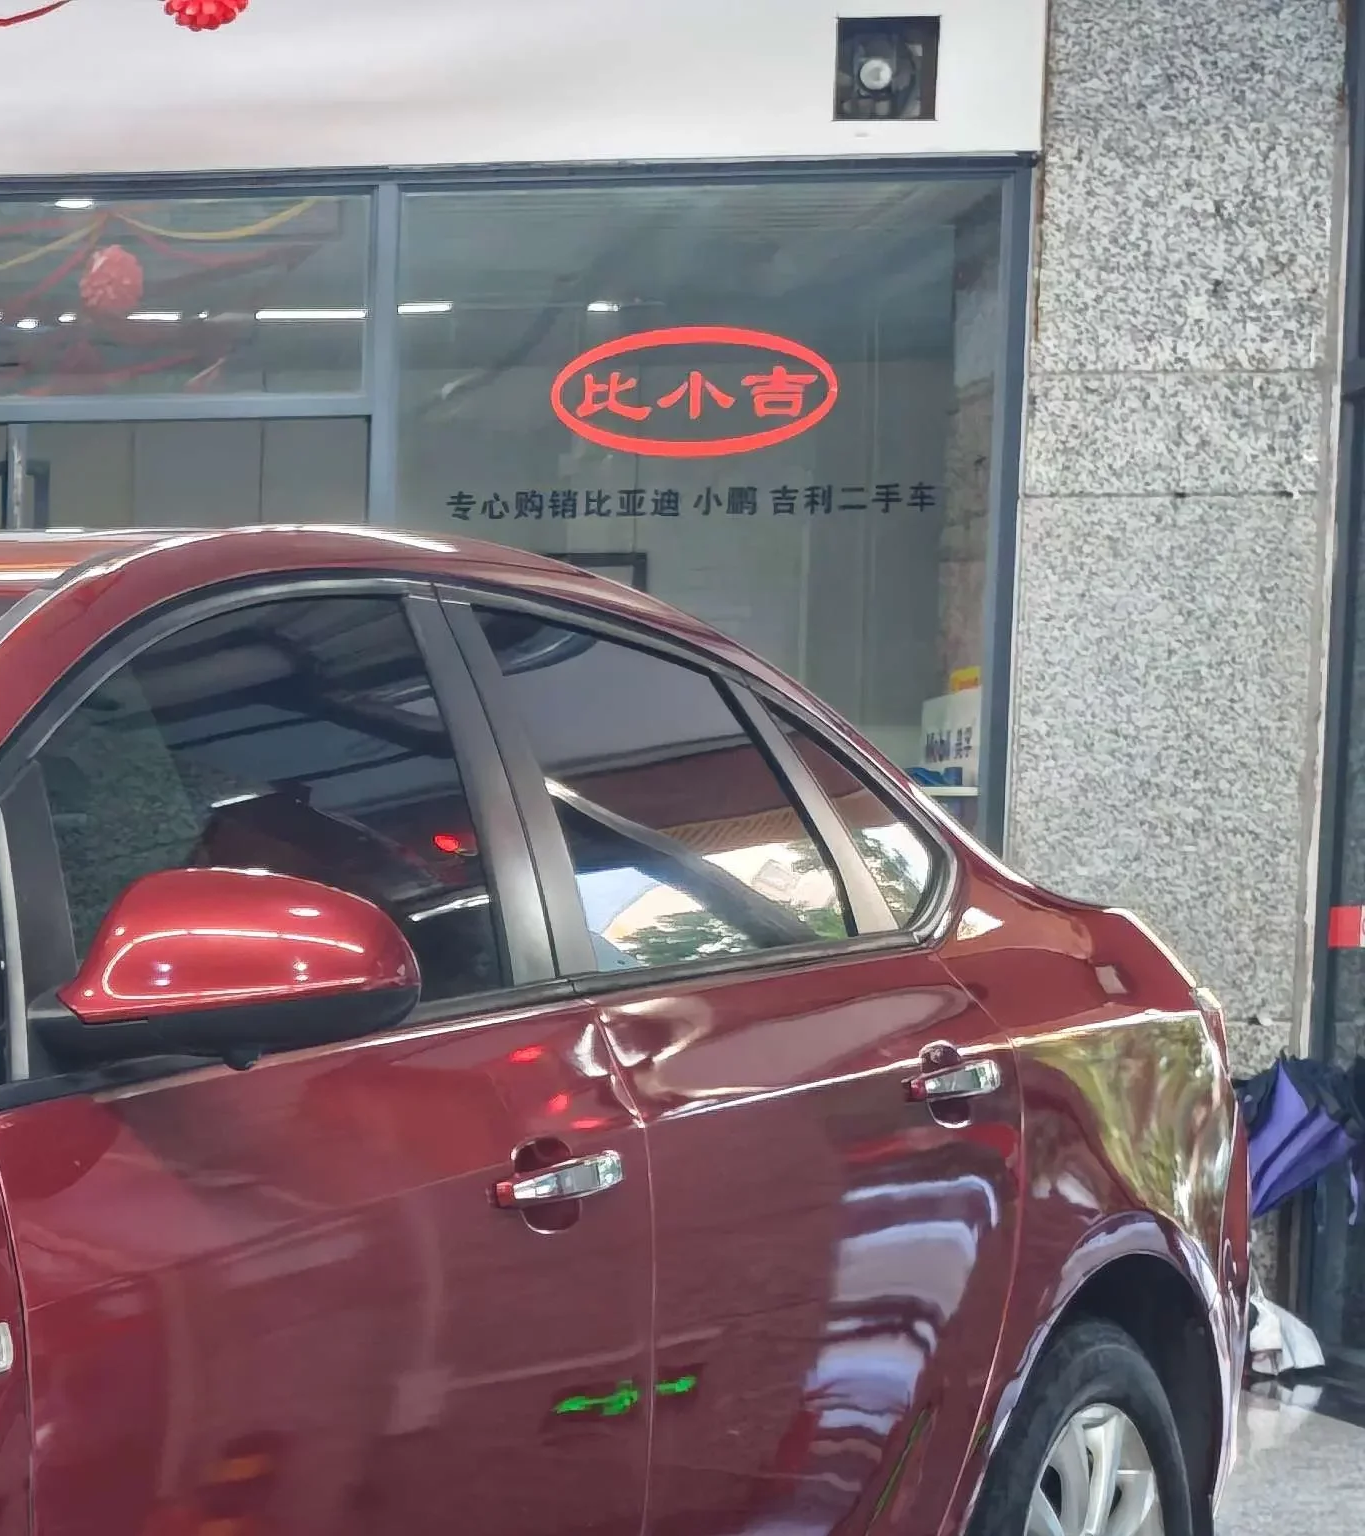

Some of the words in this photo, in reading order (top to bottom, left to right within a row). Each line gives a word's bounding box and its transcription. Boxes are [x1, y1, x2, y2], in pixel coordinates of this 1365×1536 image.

[576, 366, 818, 421] 比小吉
[446, 488, 680, 520] 专心购销比亚迪
[693, 486, 758, 516] 小鹏
[770, 483, 936, 515] 吉利二手车
